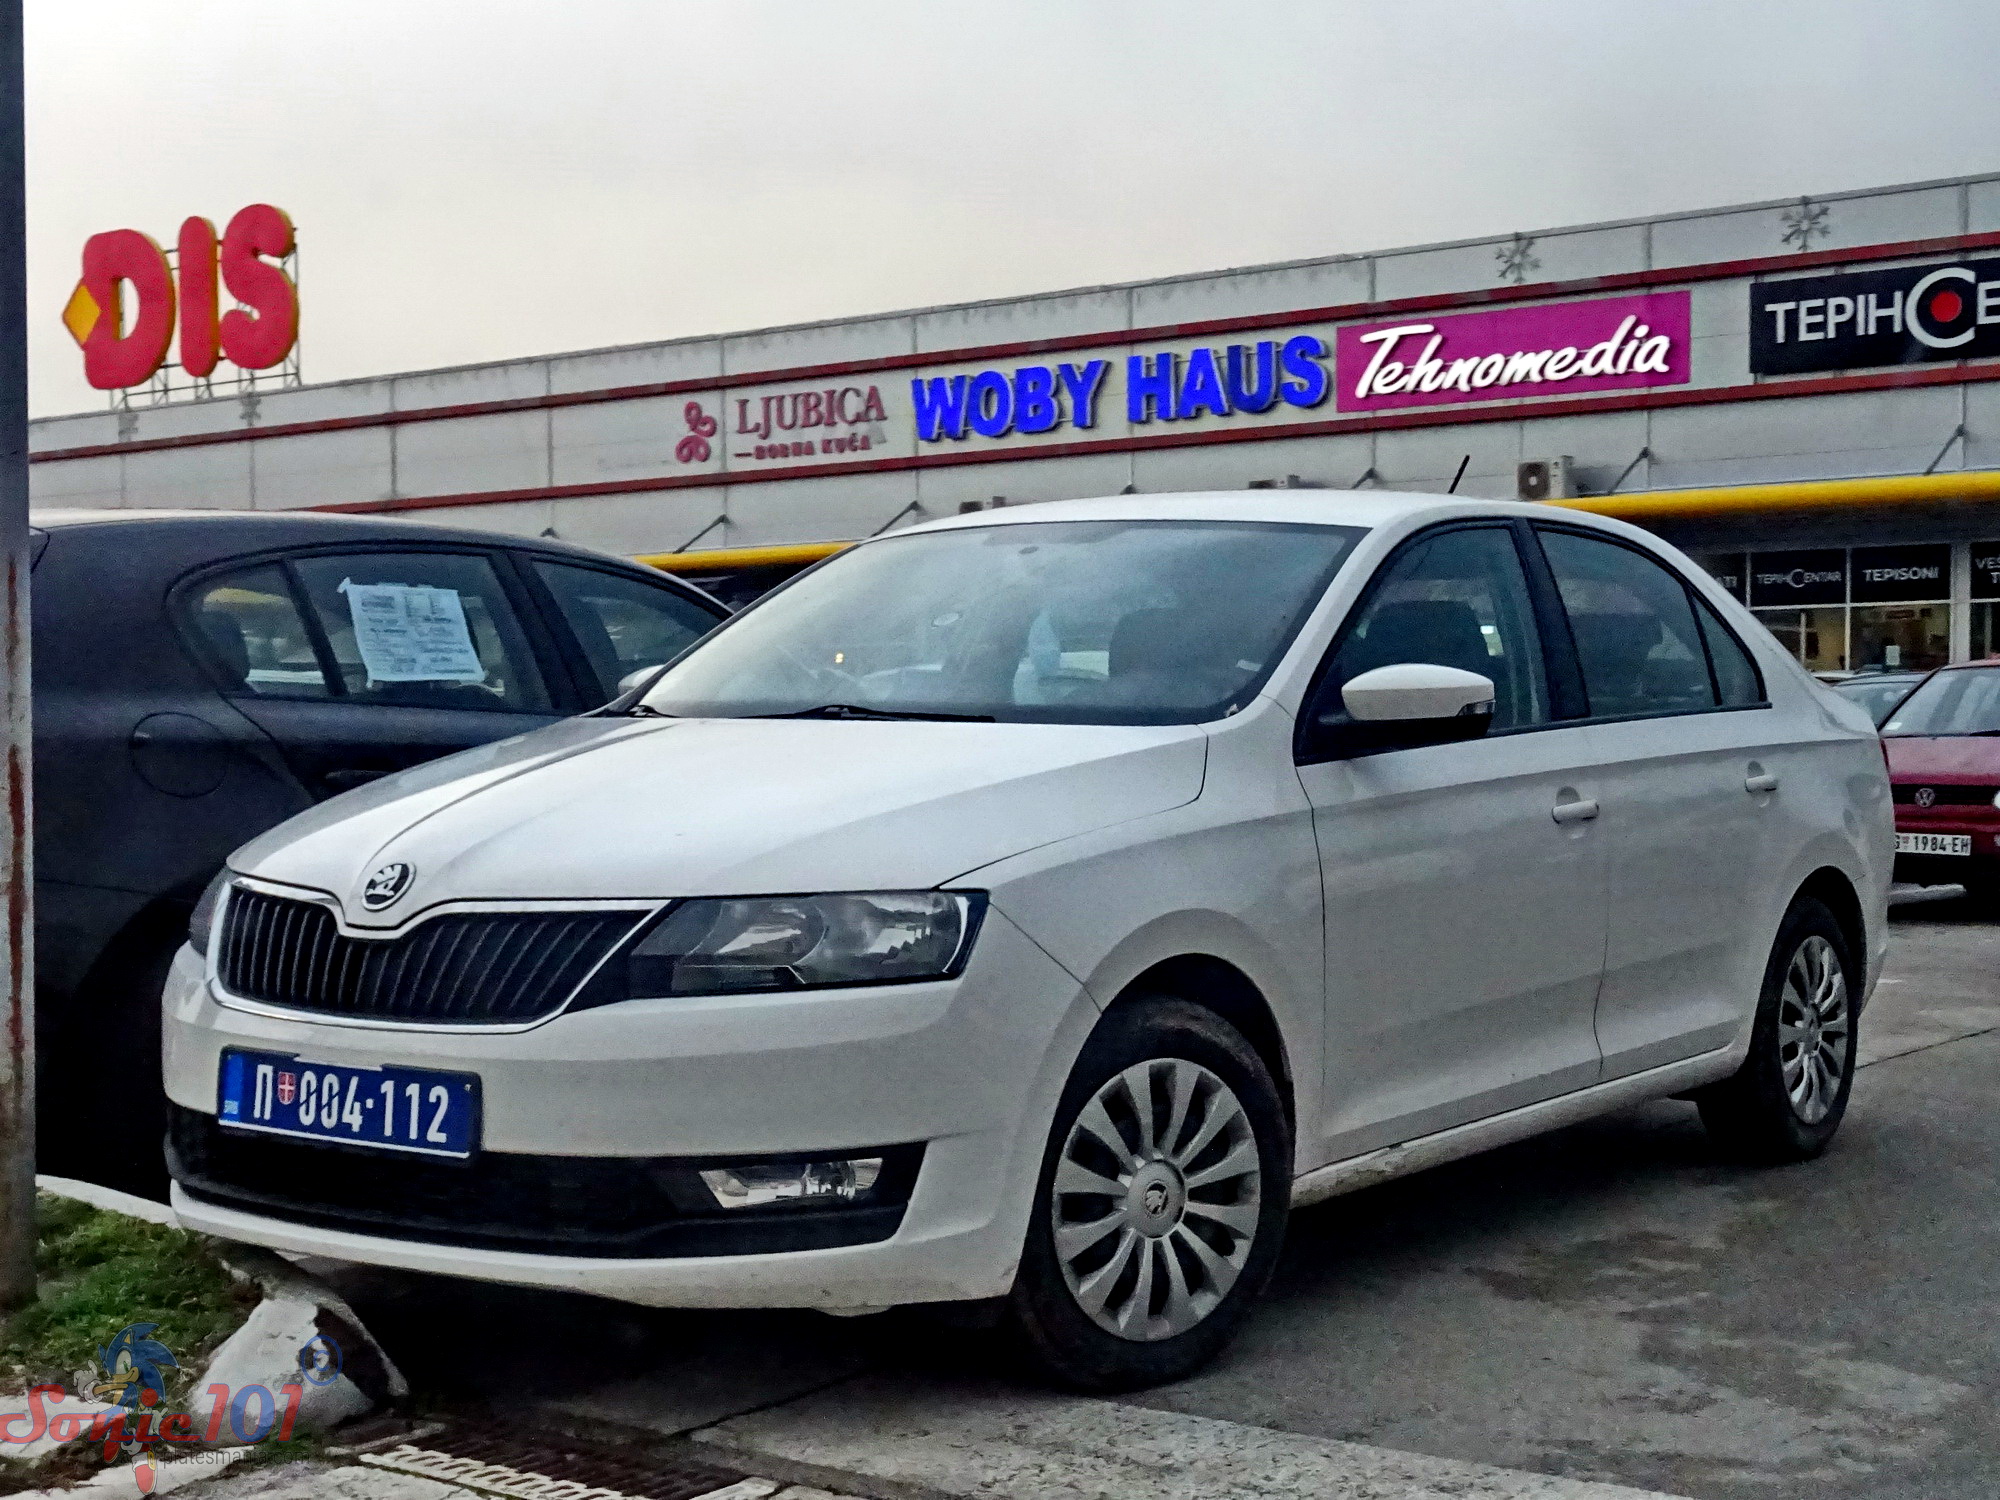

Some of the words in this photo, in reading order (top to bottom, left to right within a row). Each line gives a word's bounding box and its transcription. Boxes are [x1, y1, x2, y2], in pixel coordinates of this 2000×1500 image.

[63, 203, 299, 390] DIS
[911, 360, 1110, 441] WOBY
[1127, 335, 1326, 423] HAUS
[1356, 314, 1671, 399] Tehnomedia
[735, 385, 888, 440] LJUBICA
[1862, 566, 1939, 582] TEPISONI
